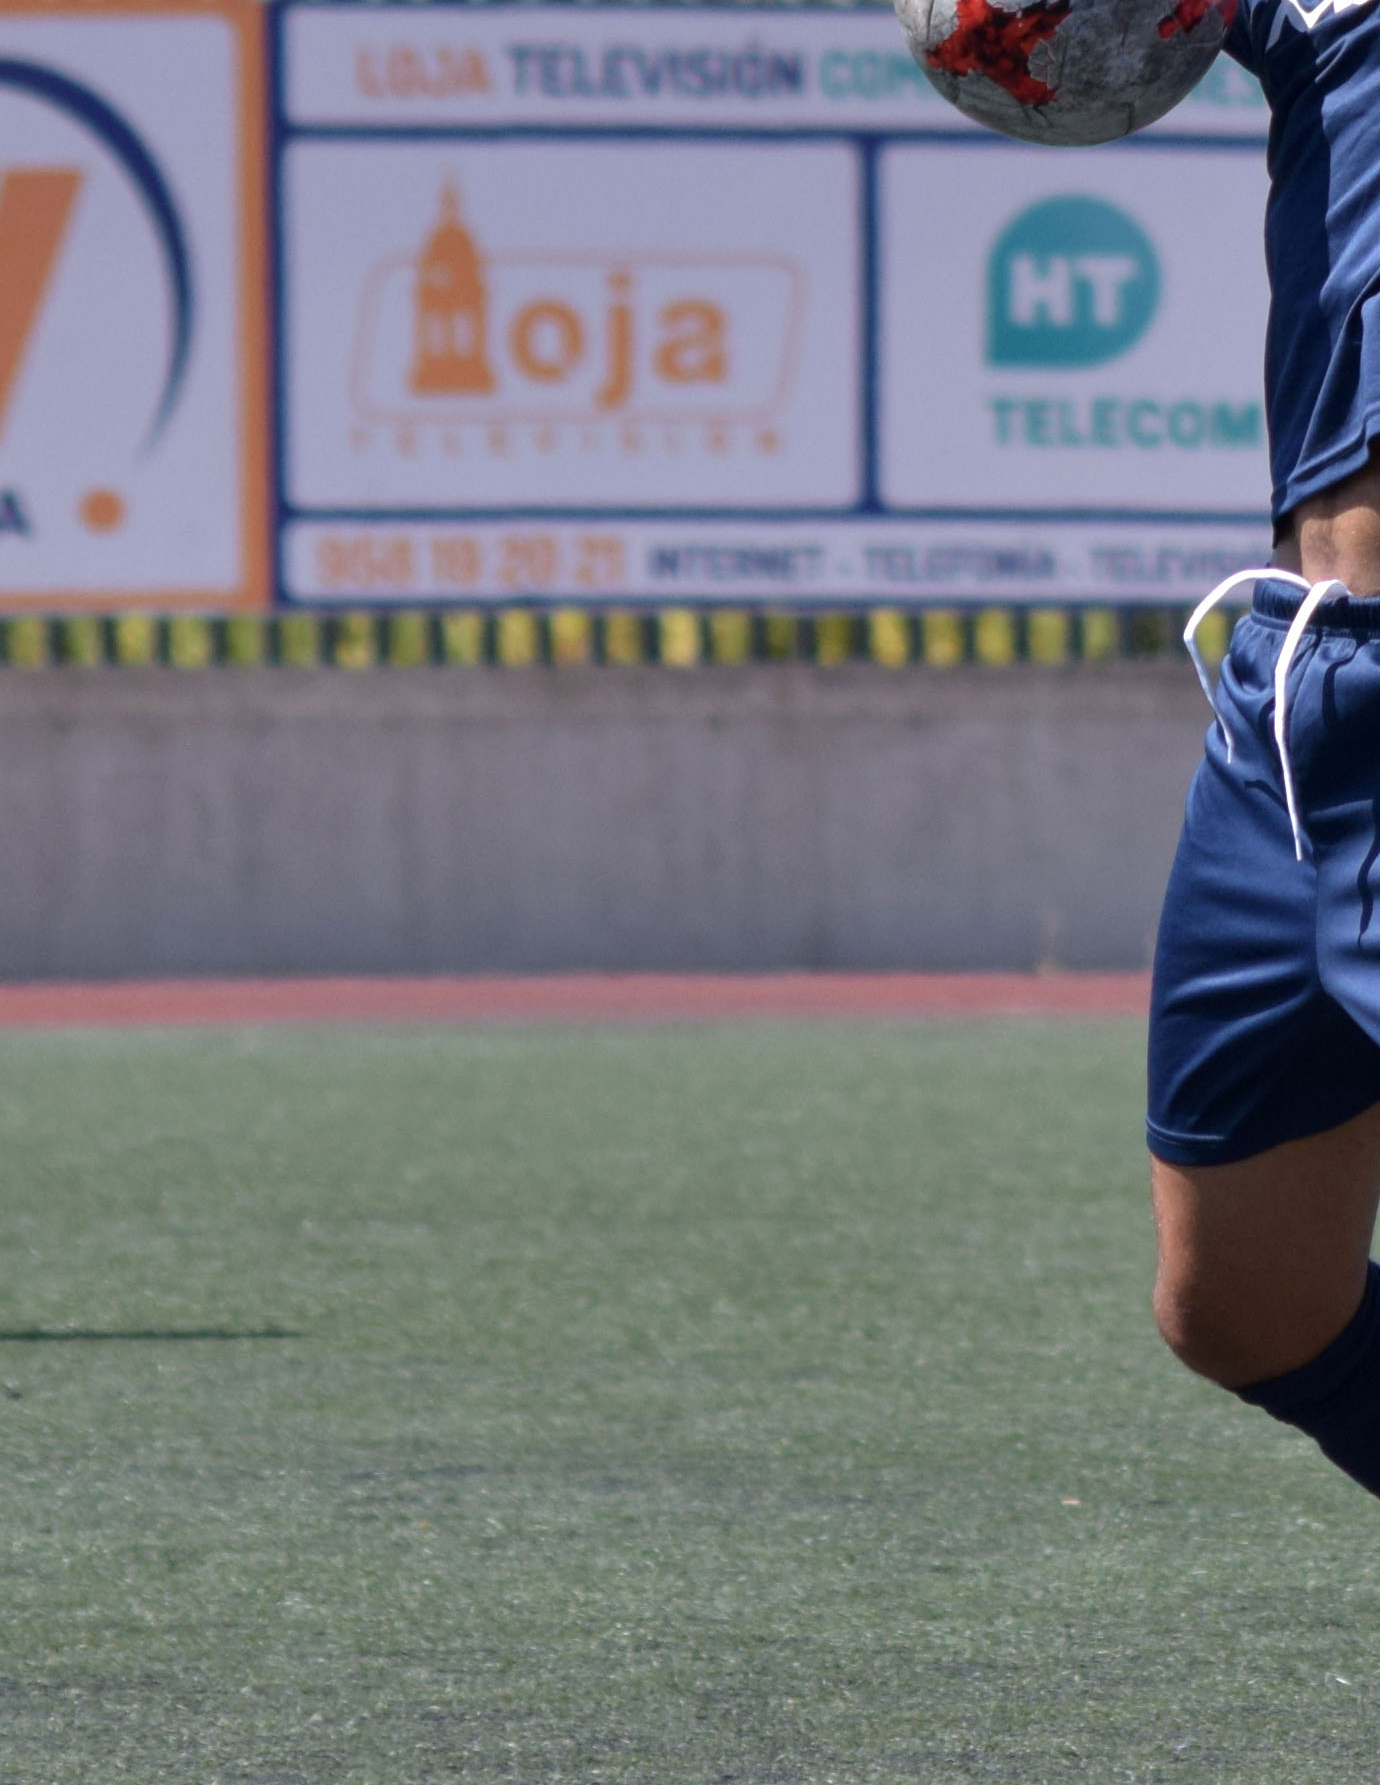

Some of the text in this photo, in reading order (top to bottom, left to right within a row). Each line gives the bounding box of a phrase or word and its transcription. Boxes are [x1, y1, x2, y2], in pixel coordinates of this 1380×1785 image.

[354, 39, 492, 100] LOJA
[1007, 253, 1138, 328] HT
[988, 396, 1261, 451] TELECOM
